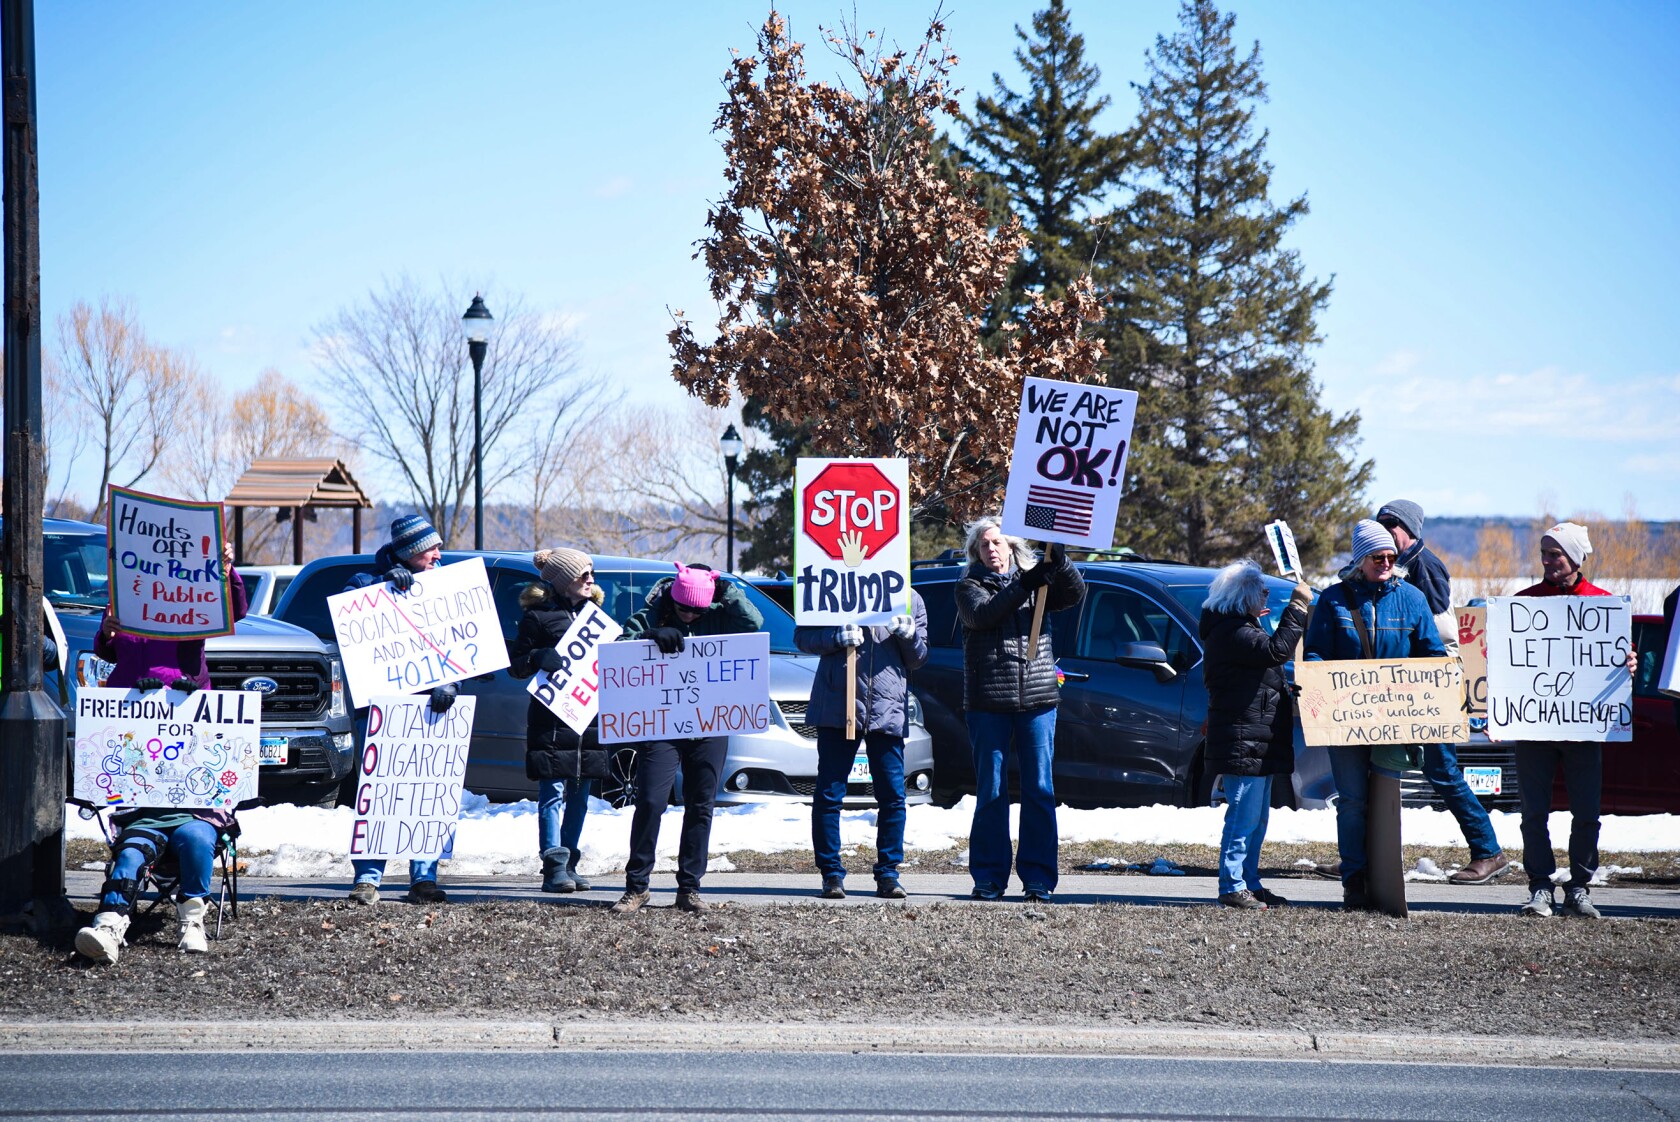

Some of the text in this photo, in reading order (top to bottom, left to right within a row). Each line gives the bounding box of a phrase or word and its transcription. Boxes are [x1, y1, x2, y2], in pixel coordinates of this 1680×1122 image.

[1027, 384, 1123, 423] WE ARE
[1035, 416, 1108, 448] NOT
[1036, 439, 1127, 489] OK!
[119, 503, 192, 540] Hands
[810, 489, 897, 533] STOP
[121, 551, 164, 576] Our
[152, 581, 219, 603] Public
[142, 603, 210, 625] Lands
[338, 584, 492, 648] SOCIAL SECURITY
[1509, 601, 1623, 634] DO NOT
[373, 621, 478, 665] AND NOW NO
[534, 610, 607, 707] DEPORT
[692, 640, 728, 659] NOT
[1508, 635, 1629, 668] LET THIS
[603, 664, 669, 690] RIGHT
[706, 658, 760, 683] LEFT
[80, 693, 255, 724] FREEDOM ALL
[661, 686, 700, 705] IT'S
[1386, 702, 1441, 717] unlocks
[1424, 691, 1434, 700] a
[157, 723, 194, 736] FOR
[601, 709, 670, 739] RIGHT
[695, 704, 767, 733] WRONG
[1346, 723, 1465, 743] MORE POWER
[362, 742, 468, 778] OLIGARCHS
[1486, 774, 1499, 787] 297
[357, 782, 461, 817] GRIFTERS
[350, 819, 457, 855] EVIL DOERS
